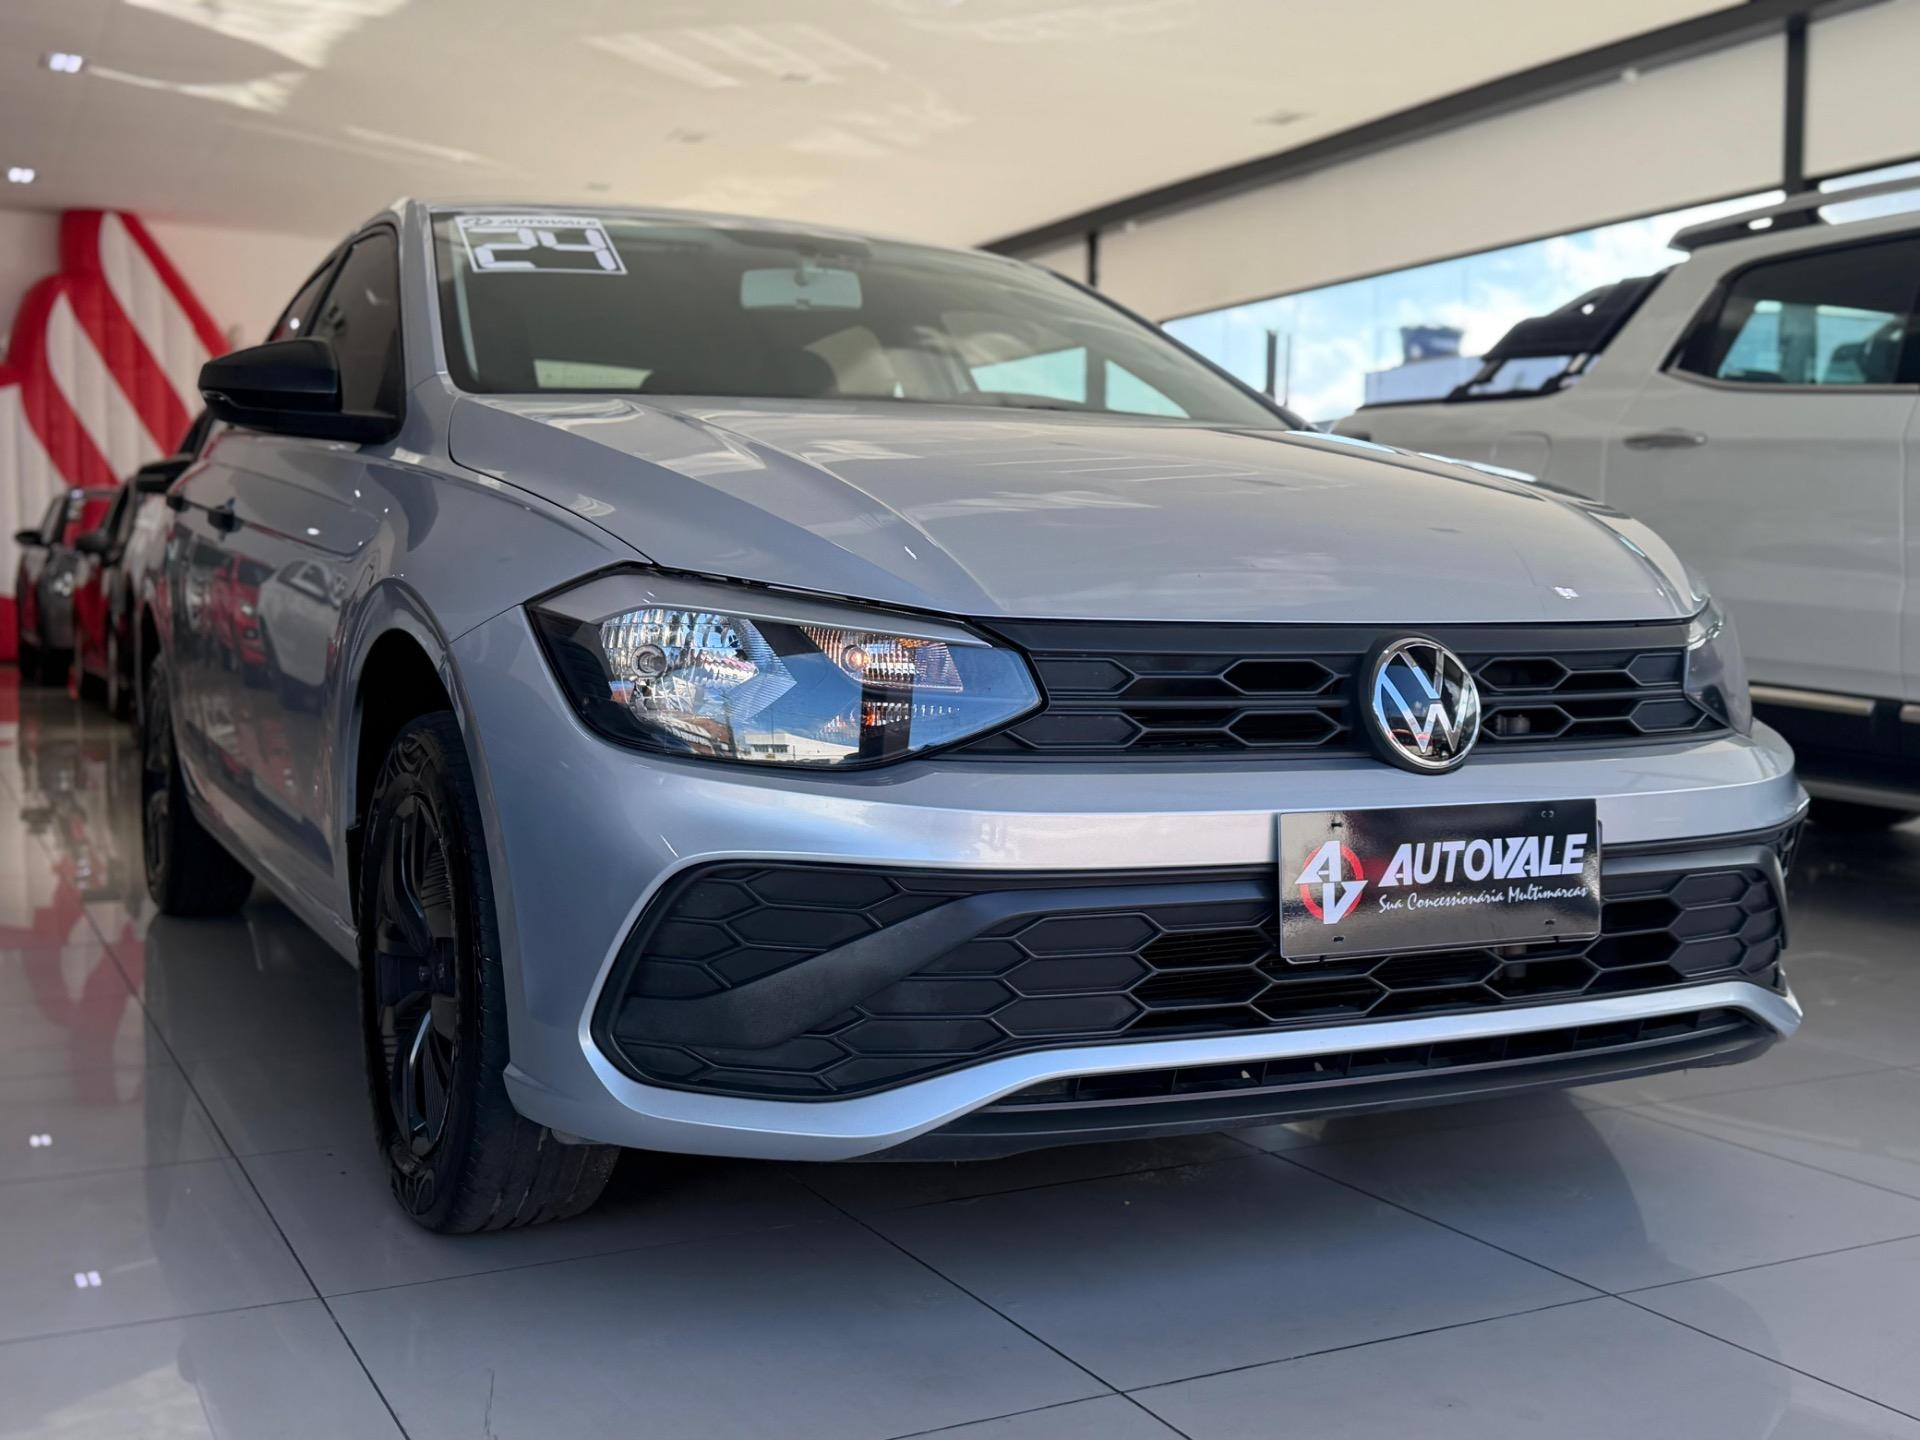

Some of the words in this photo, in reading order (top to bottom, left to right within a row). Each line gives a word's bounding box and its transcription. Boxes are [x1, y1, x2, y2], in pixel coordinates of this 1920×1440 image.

[499, 217, 597, 227] AUTOVALE
[467, 228, 617, 271] 24
[1372, 637, 1481, 769] VW
[1378, 833, 1588, 887] AUTOVALE
[1379, 893, 1403, 913] Sua
[1407, 890, 1505, 911] Concessionária
[1508, 883, 1589, 903] Multimarcas
